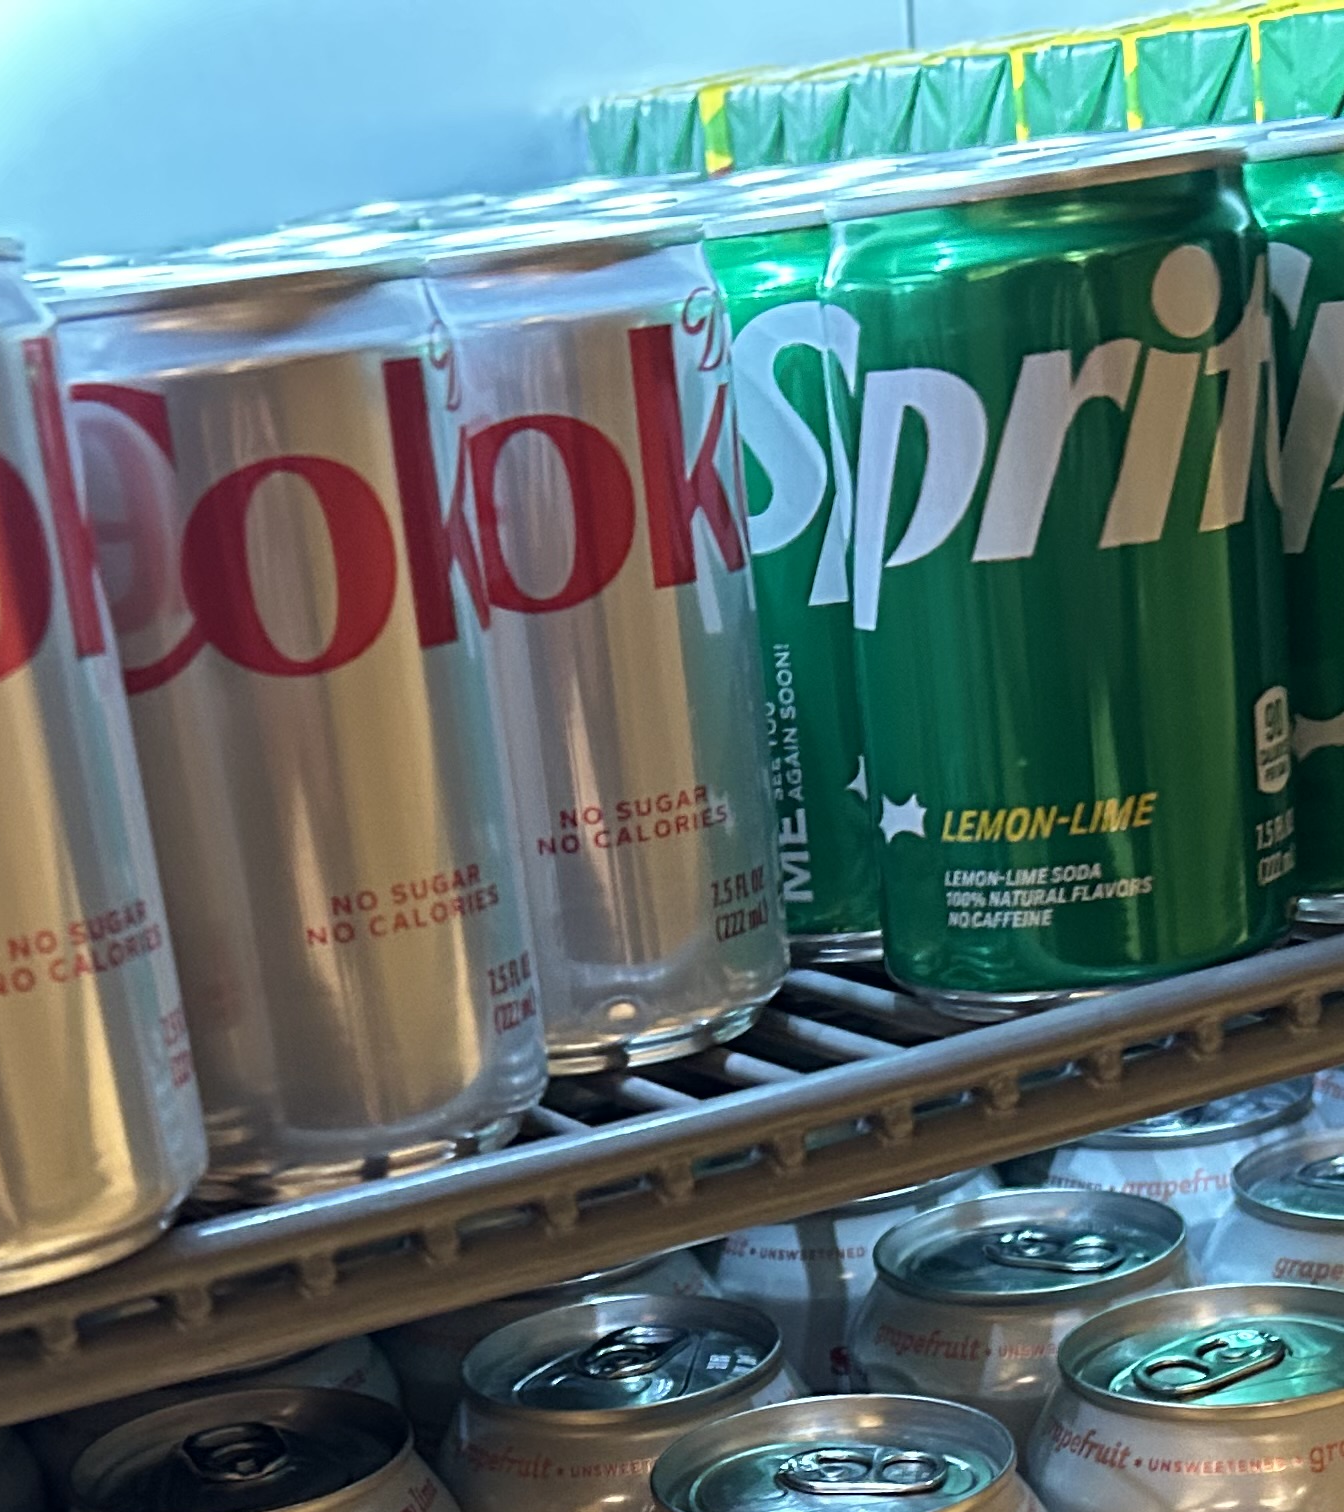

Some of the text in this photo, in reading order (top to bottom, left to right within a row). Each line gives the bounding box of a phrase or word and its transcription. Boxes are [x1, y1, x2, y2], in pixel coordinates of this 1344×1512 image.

[824, 243, 1270, 632] prit
[772, 643, 794, 719] SOON!
[783, 723, 805, 803] AGAIN
[537, 803, 729, 857] NO CALORIES
[559, 783, 709, 830] NO SUGAR
[940, 790, 1159, 843] LEMON-LIME
[777, 807, 814, 905] ME
[943, 862, 1103, 888] LEMON-LIME SODA
[305, 884, 501, 946] NO CALORIES
[330, 862, 482, 917] NO SUGAR
[988, 884, 1070, 909] NATURAL
[1071, 875, 1154, 902] FLAVORS
[7, 898, 150, 962] NO SUGAR
[947, 907, 1054, 929] NO CAFFEINE
[875, 1322, 981, 1363] grapefruit
[1146, 1455, 1290, 1475] UNSWEETENED
